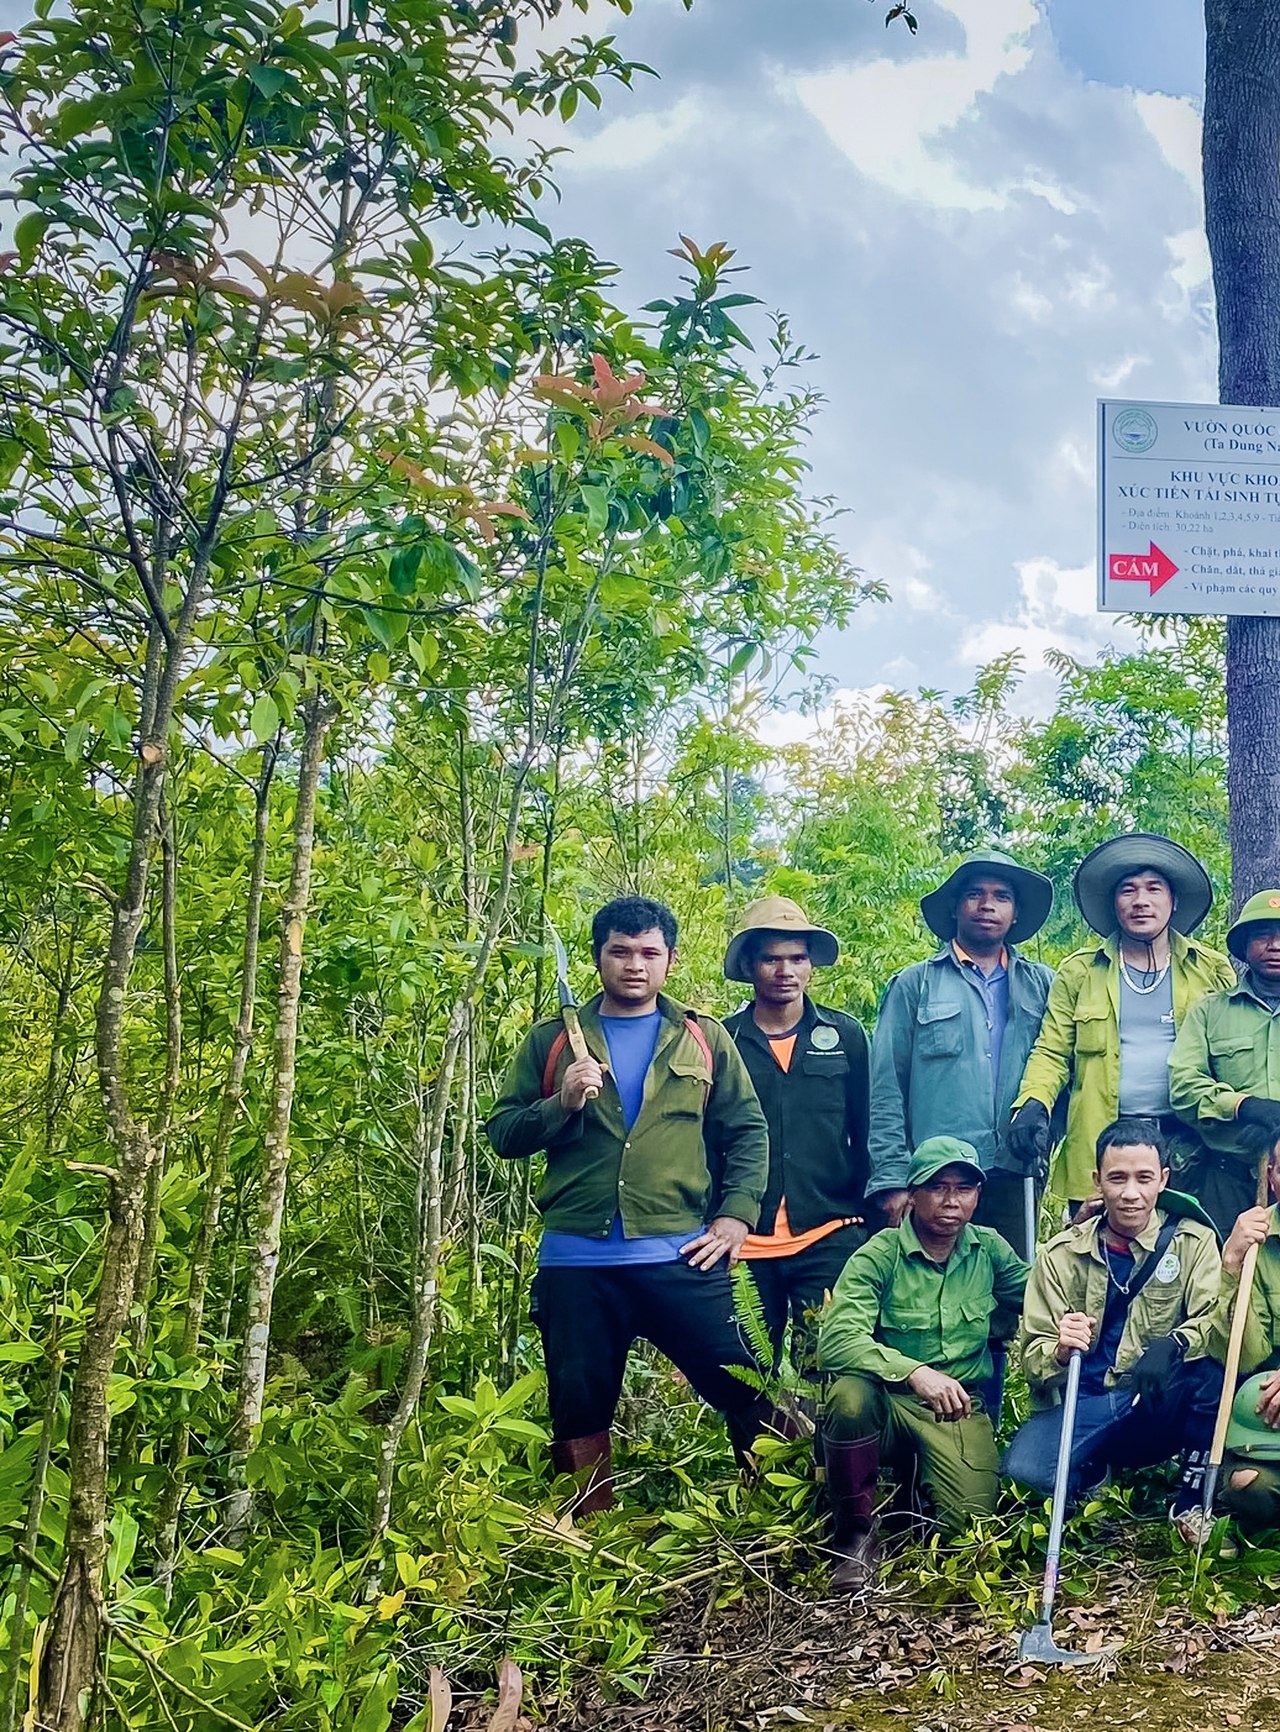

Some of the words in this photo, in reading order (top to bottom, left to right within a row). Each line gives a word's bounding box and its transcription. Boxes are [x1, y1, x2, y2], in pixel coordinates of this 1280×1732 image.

[1184, 420, 1228, 434] VƯỜN
[1232, 422, 1275, 437] QUỐC
[1204, 439, 1224, 451] (Ta
[1229, 440, 1263, 453] Dung
[1171, 471, 1203, 482] KHU
[1208, 472, 1240, 486] VỰC
[1118, 484, 1150, 498] XÚC
[1154, 485, 1190, 499] TIẾN
[1195, 486, 1220, 501] TÁI
[1224, 492, 1259, 502] SINH
[1203, 525, 1213, 533] ha
[1249, 547, 1271, 558] khai
[1113, 557, 1158, 576] CẤM
[1191, 582, 1202, 592] Vi
[1206, 584, 1235, 595] phạm
[1239, 583, 1255, 593] các
[1259, 588, 1277, 596] quy
